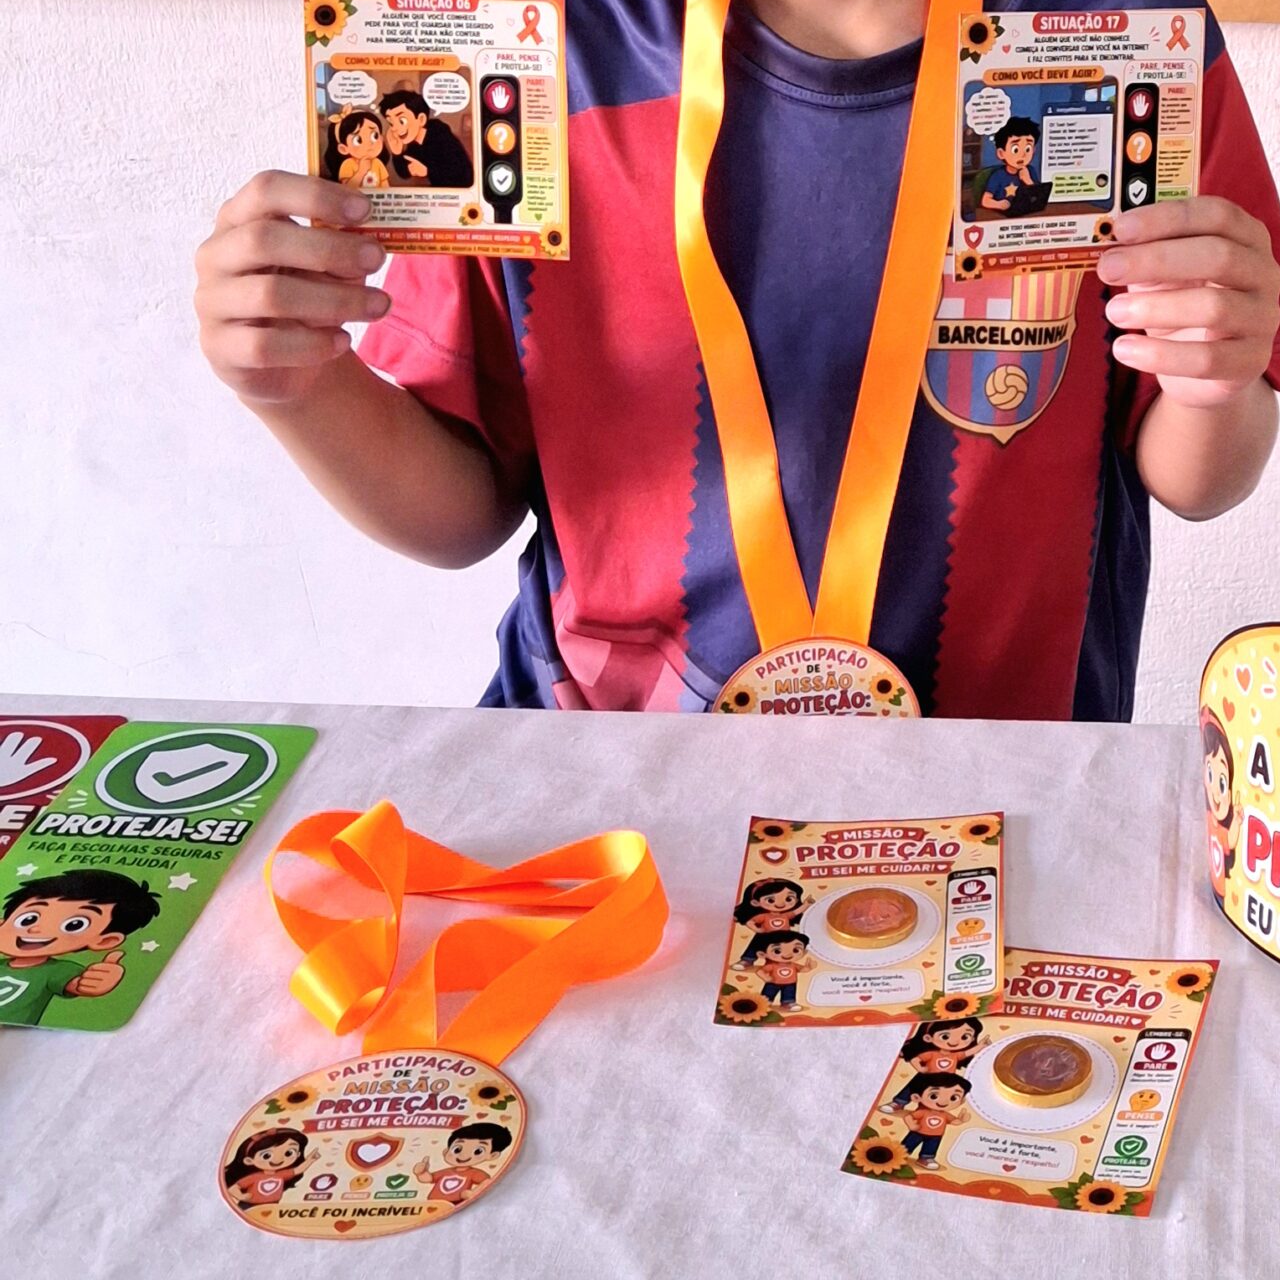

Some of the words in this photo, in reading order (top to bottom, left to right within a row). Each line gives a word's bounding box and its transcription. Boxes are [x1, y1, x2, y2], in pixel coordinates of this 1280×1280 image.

[1040, 13, 1102, 33] SITUAÇÃO
[1107, 15, 1120, 29] 17
[992, 71, 1018, 82] COMO
[1047, 69, 1070, 80] DEVE
[755, 648, 868, 679] PARTICIPAÇÃO
[806, 664, 820, 674] DE
[775, 671, 854, 695] MISSÃO
[1251, 742, 1271, 786] A
[37, 812, 245, 844] PROTEJA-SE!
[843, 827, 904, 841] MISSÃO
[27, 841, 66, 853] FAÇA
[70, 842, 148, 856] ESCOLHAS
[151, 846, 223, 860] SEGURAS
[796, 838, 961, 864] PROTEÇÃO
[54, 853, 63, 863] E
[72, 854, 111, 866] PEÇA
[115, 856, 178, 870] AJUDA!
[811, 867, 829, 877] EU
[831, 866, 854, 876] SEI
[856, 864, 878, 875] ME
[880, 862, 936, 875] CUIDAR!
[1247, 897, 1273, 937] EU
[1044, 964, 1109, 980] MISSÃO
[1020, 1005, 1042, 1017] SEI
[1046, 1007, 1067, 1019] ME
[1071, 1010, 1130, 1026] CUIDAR!
[327, 1055, 476, 1081] PARTICIPAÇÃO
[393, 1069, 411, 1078] DE
[343, 1076, 450, 1096] MISSÃO
[316, 1093, 468, 1115] PROTEÇÃO:
[317, 1119, 337, 1131] EU
[340, 1117, 364, 1129] SEI
[366, 1116, 388, 1128] ME
[391, 1114, 453, 1128] CUIDAR!
[277, 1206, 318, 1219] VOCÊ
[321, 1207, 348, 1218] FOI
[351, 1205, 423, 1217] INCRÍVEL!
